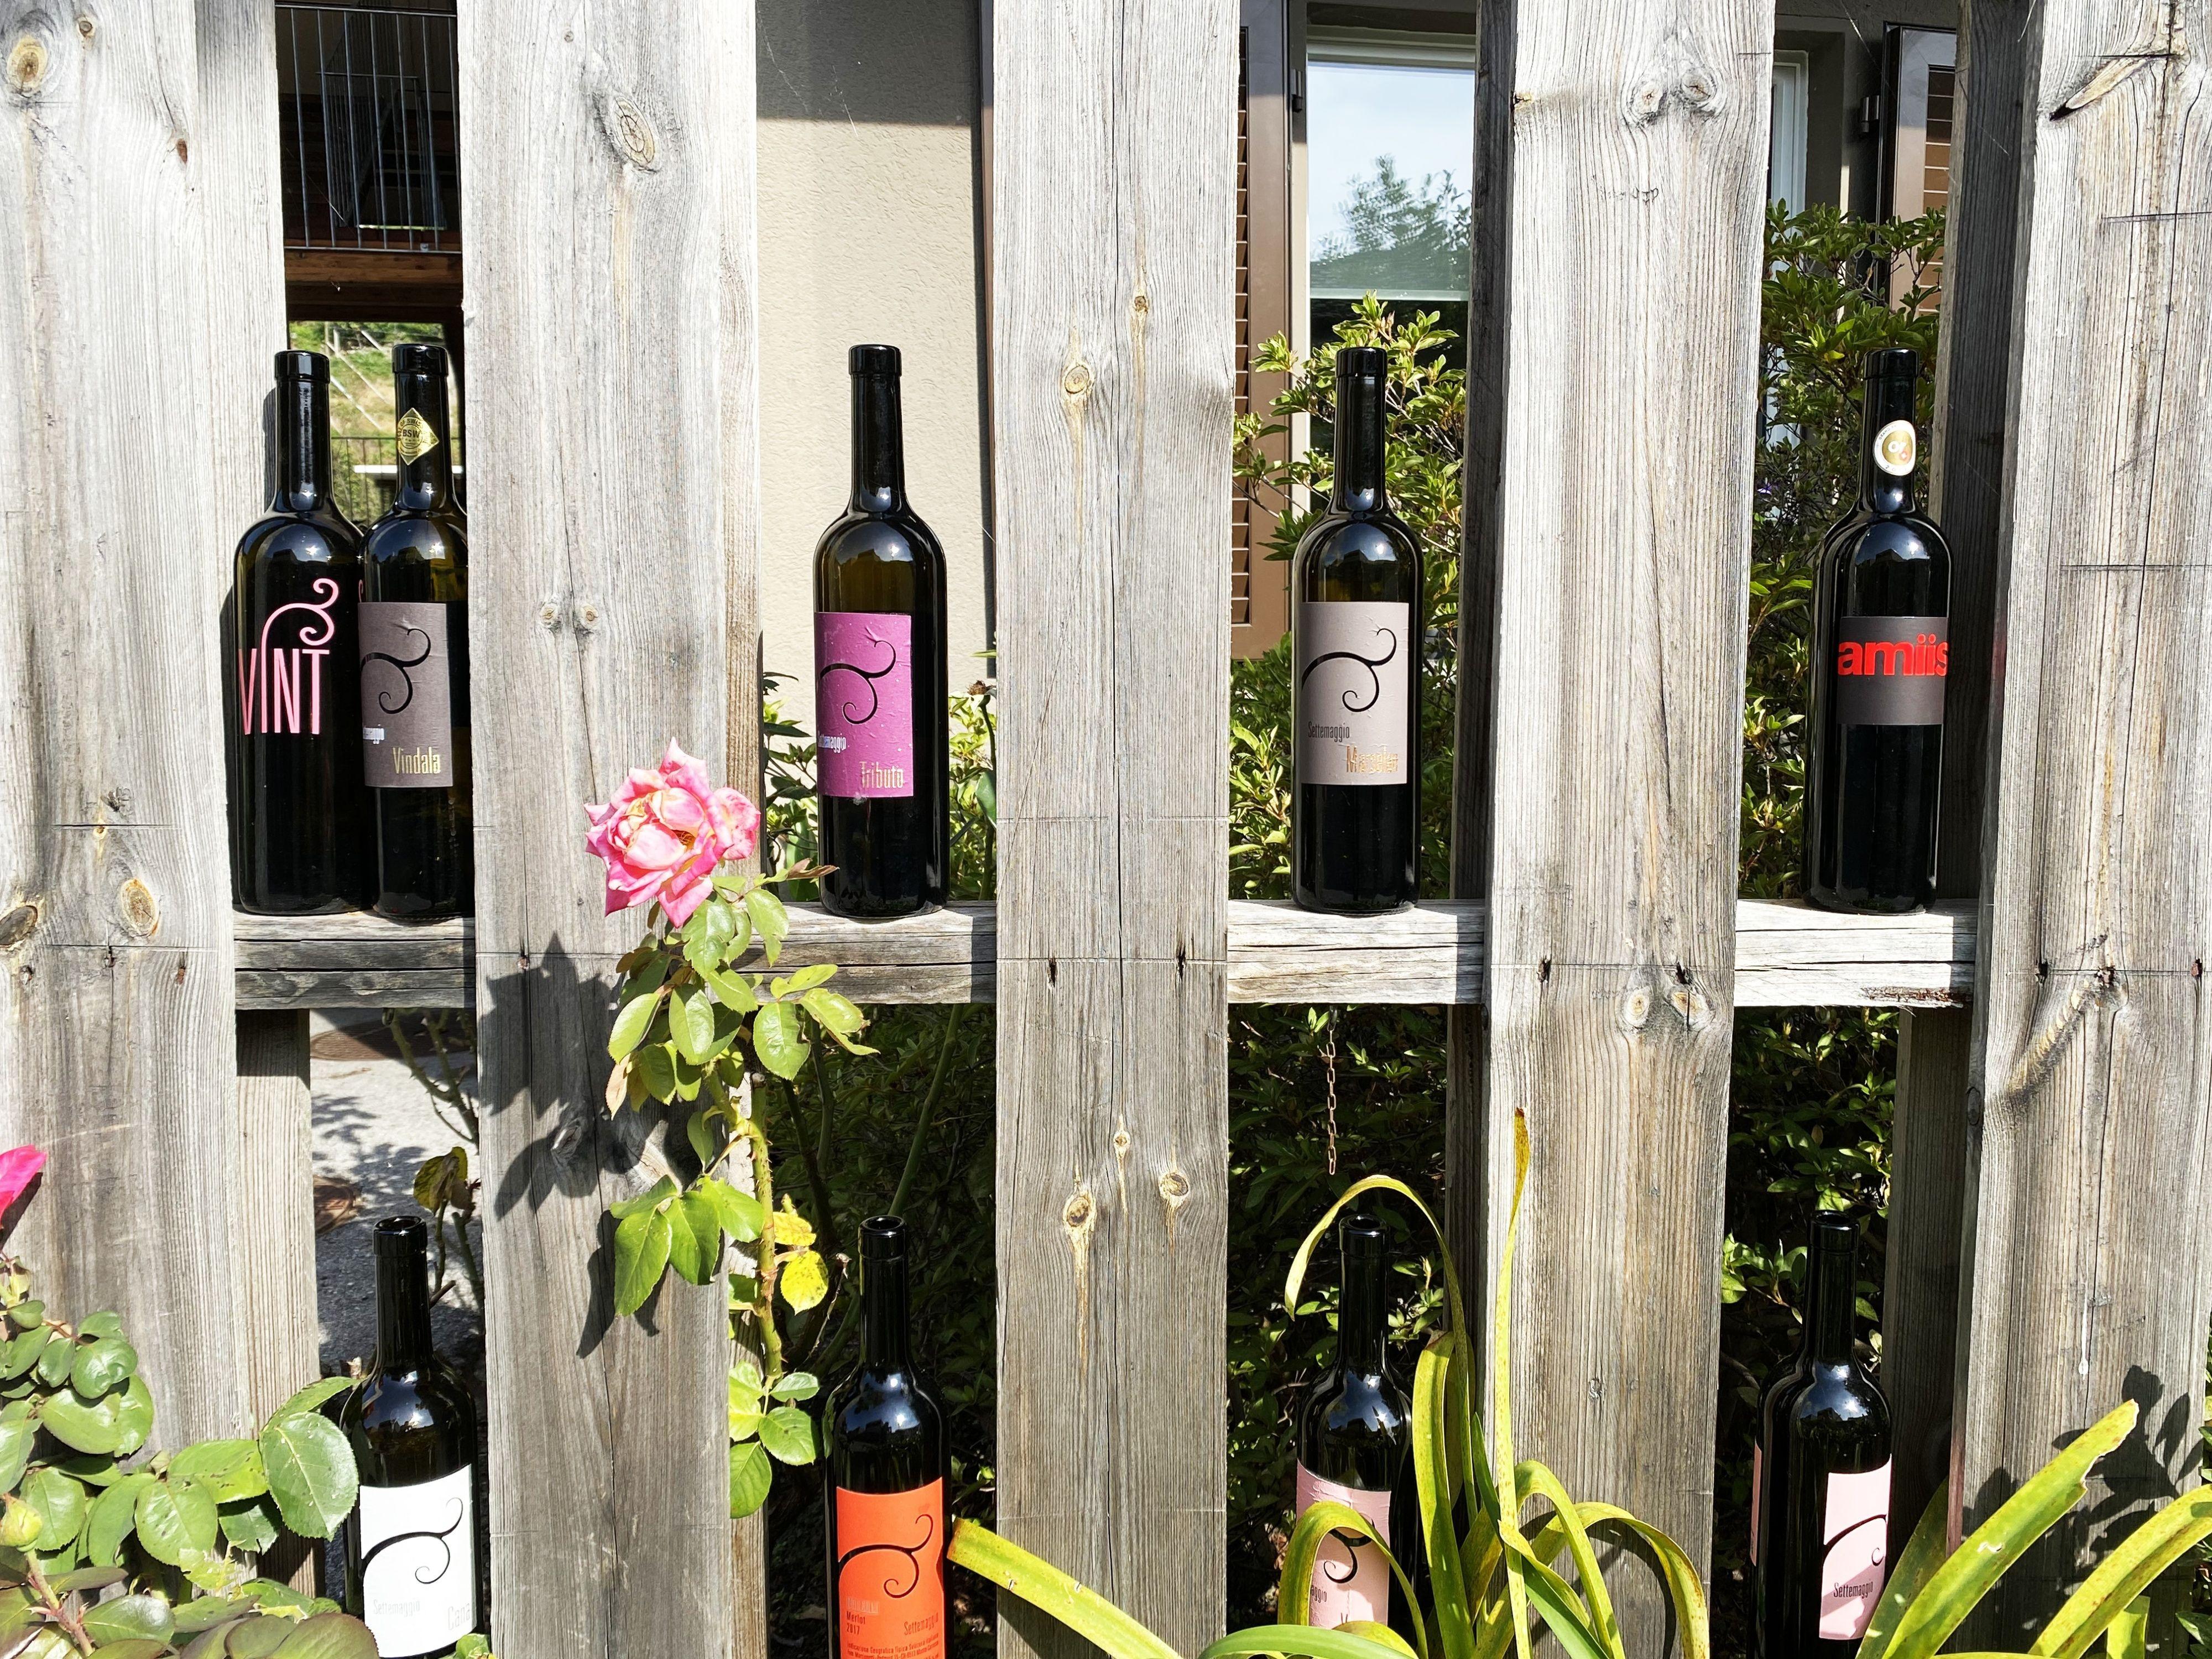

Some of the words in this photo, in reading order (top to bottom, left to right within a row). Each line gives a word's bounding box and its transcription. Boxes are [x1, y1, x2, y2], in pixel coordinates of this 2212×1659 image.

[403, 429, 420, 439] BSW
[1838, 633, 1949, 676] amiis
[238, 648, 330, 735] VINT
[1308, 721, 1350, 743] Settemaggio
[392, 746, 441, 774] Vindala
[859, 761, 904, 789] Tributo
[1833, 1578, 1874, 1599] Settemaggio
[373, 1598, 420, 1618] Settemaggio
[846, 1610, 865, 1625] Merlot
[846, 1623, 860, 1636] 2017
[904, 1611, 939, 1636] Settemaggio
